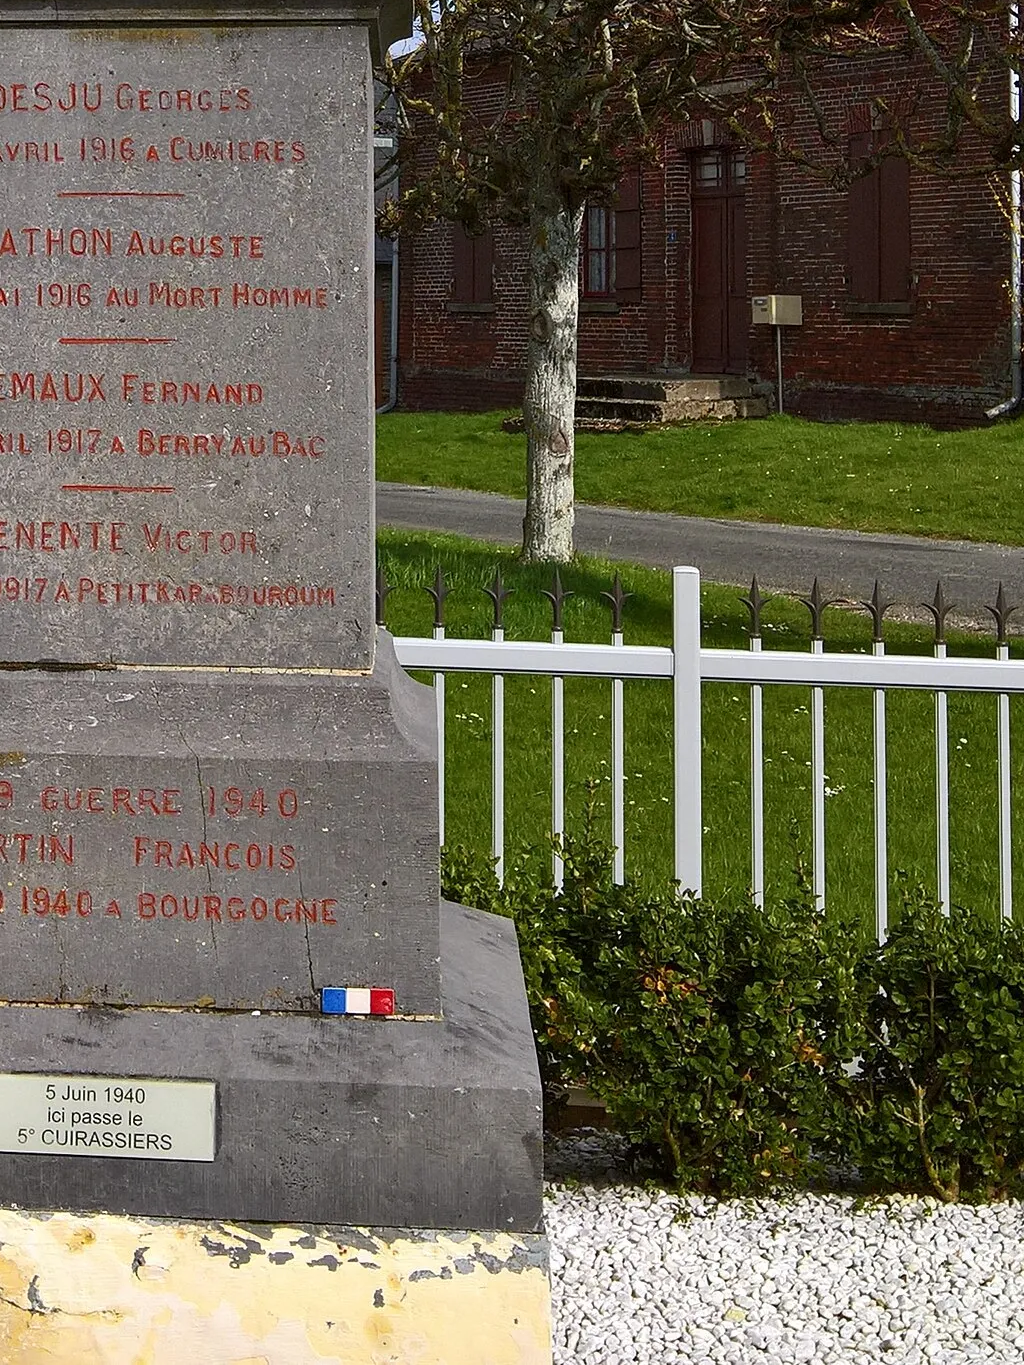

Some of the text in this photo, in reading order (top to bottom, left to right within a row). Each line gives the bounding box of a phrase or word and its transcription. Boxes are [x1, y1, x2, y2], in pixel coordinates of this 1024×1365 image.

[114, 82, 250, 114] GEORGES
[78, 136, 135, 164] 1916
[144, 144, 161, 164] A
[168, 136, 306, 164] CUMIERES
[125, 229, 265, 261] AUGUSTE
[34, 281, 92, 308] 1916
[104, 286, 140, 309] AU
[148, 280, 224, 310] MORT
[230, 281, 328, 309] HOMME
[119, 372, 265, 408] FERNAND
[46, 427, 103, 455] 1917
[110, 434, 127, 455] A
[136, 427, 226, 458] BERRY
[230, 434, 268, 457] AU
[270, 429, 326, 459] BAC
[141, 523, 258, 556] VICTOR
[38, 785, 181, 818] GUERRE
[207, 785, 299, 821] 1940
[132, 835, 297, 872] FRANCOIS
[20, 885, 93, 919] 1940
[104, 899, 123, 917] A
[135, 891, 338, 926] BOURGOGNE
[45, 1084, 146, 1105] 5 Juin 1940
[47, 1107, 144, 1128] ici passe le
[40, 1128, 173, 1151] CUIRASSIERS
